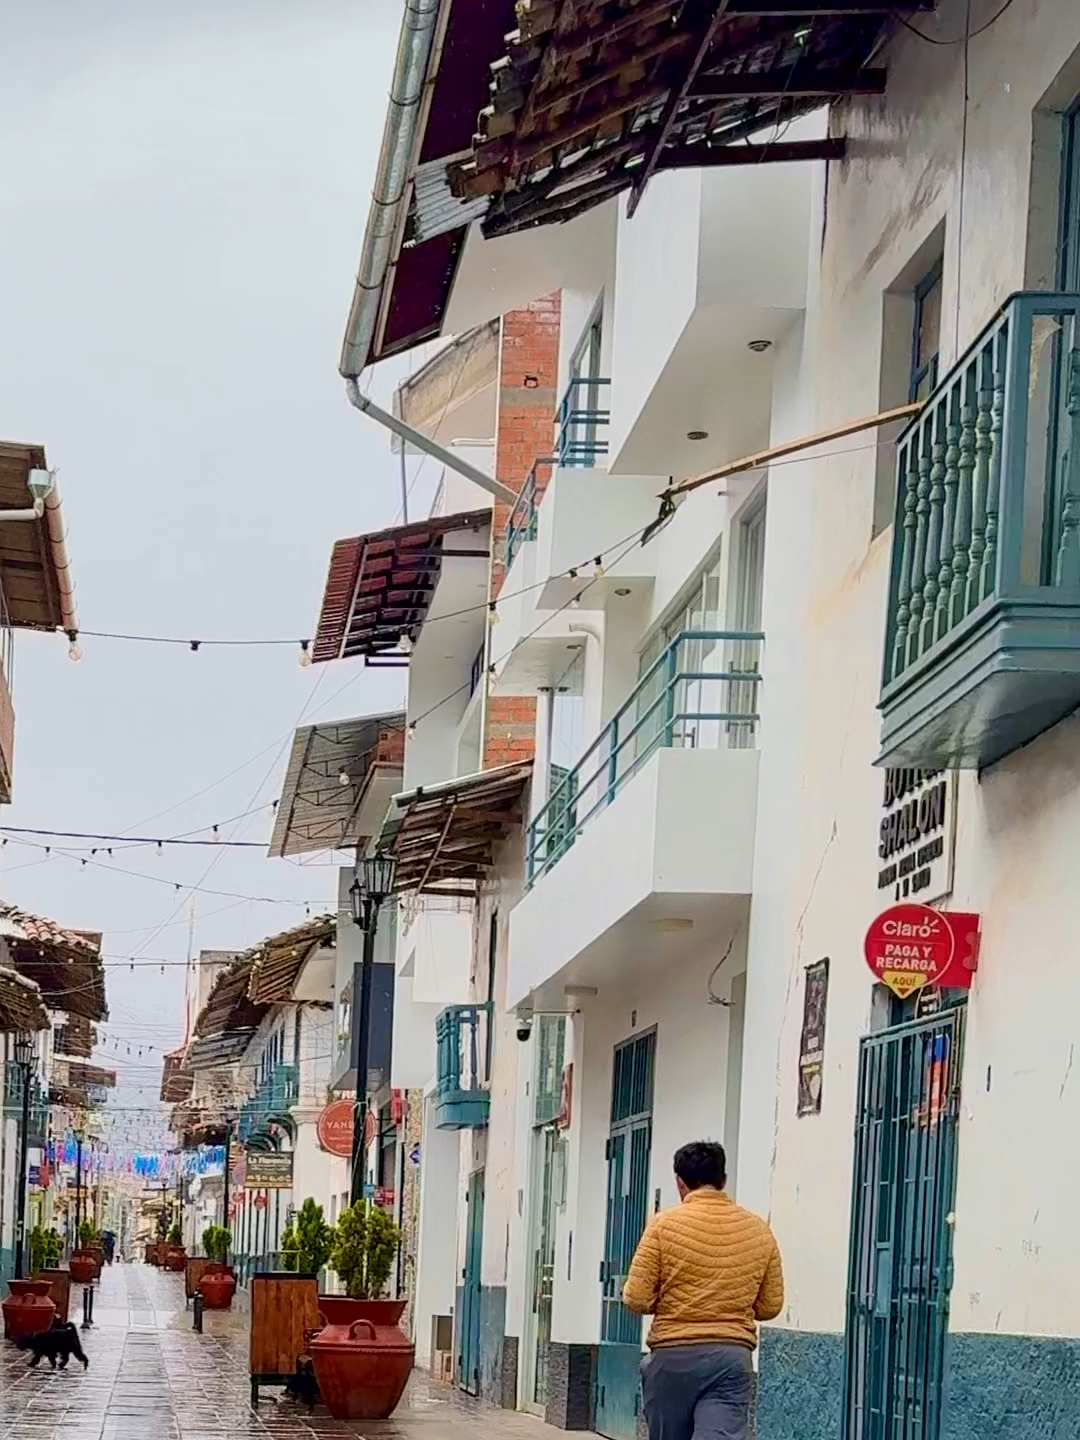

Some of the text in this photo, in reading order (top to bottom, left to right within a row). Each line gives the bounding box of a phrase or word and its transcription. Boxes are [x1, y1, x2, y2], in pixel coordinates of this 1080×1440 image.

[878, 780, 947, 860] SHALON
[882, 917, 934, 938] Claro
[885, 943, 933, 959] PAGA Y
[876, 956, 937, 971] RECARGA
